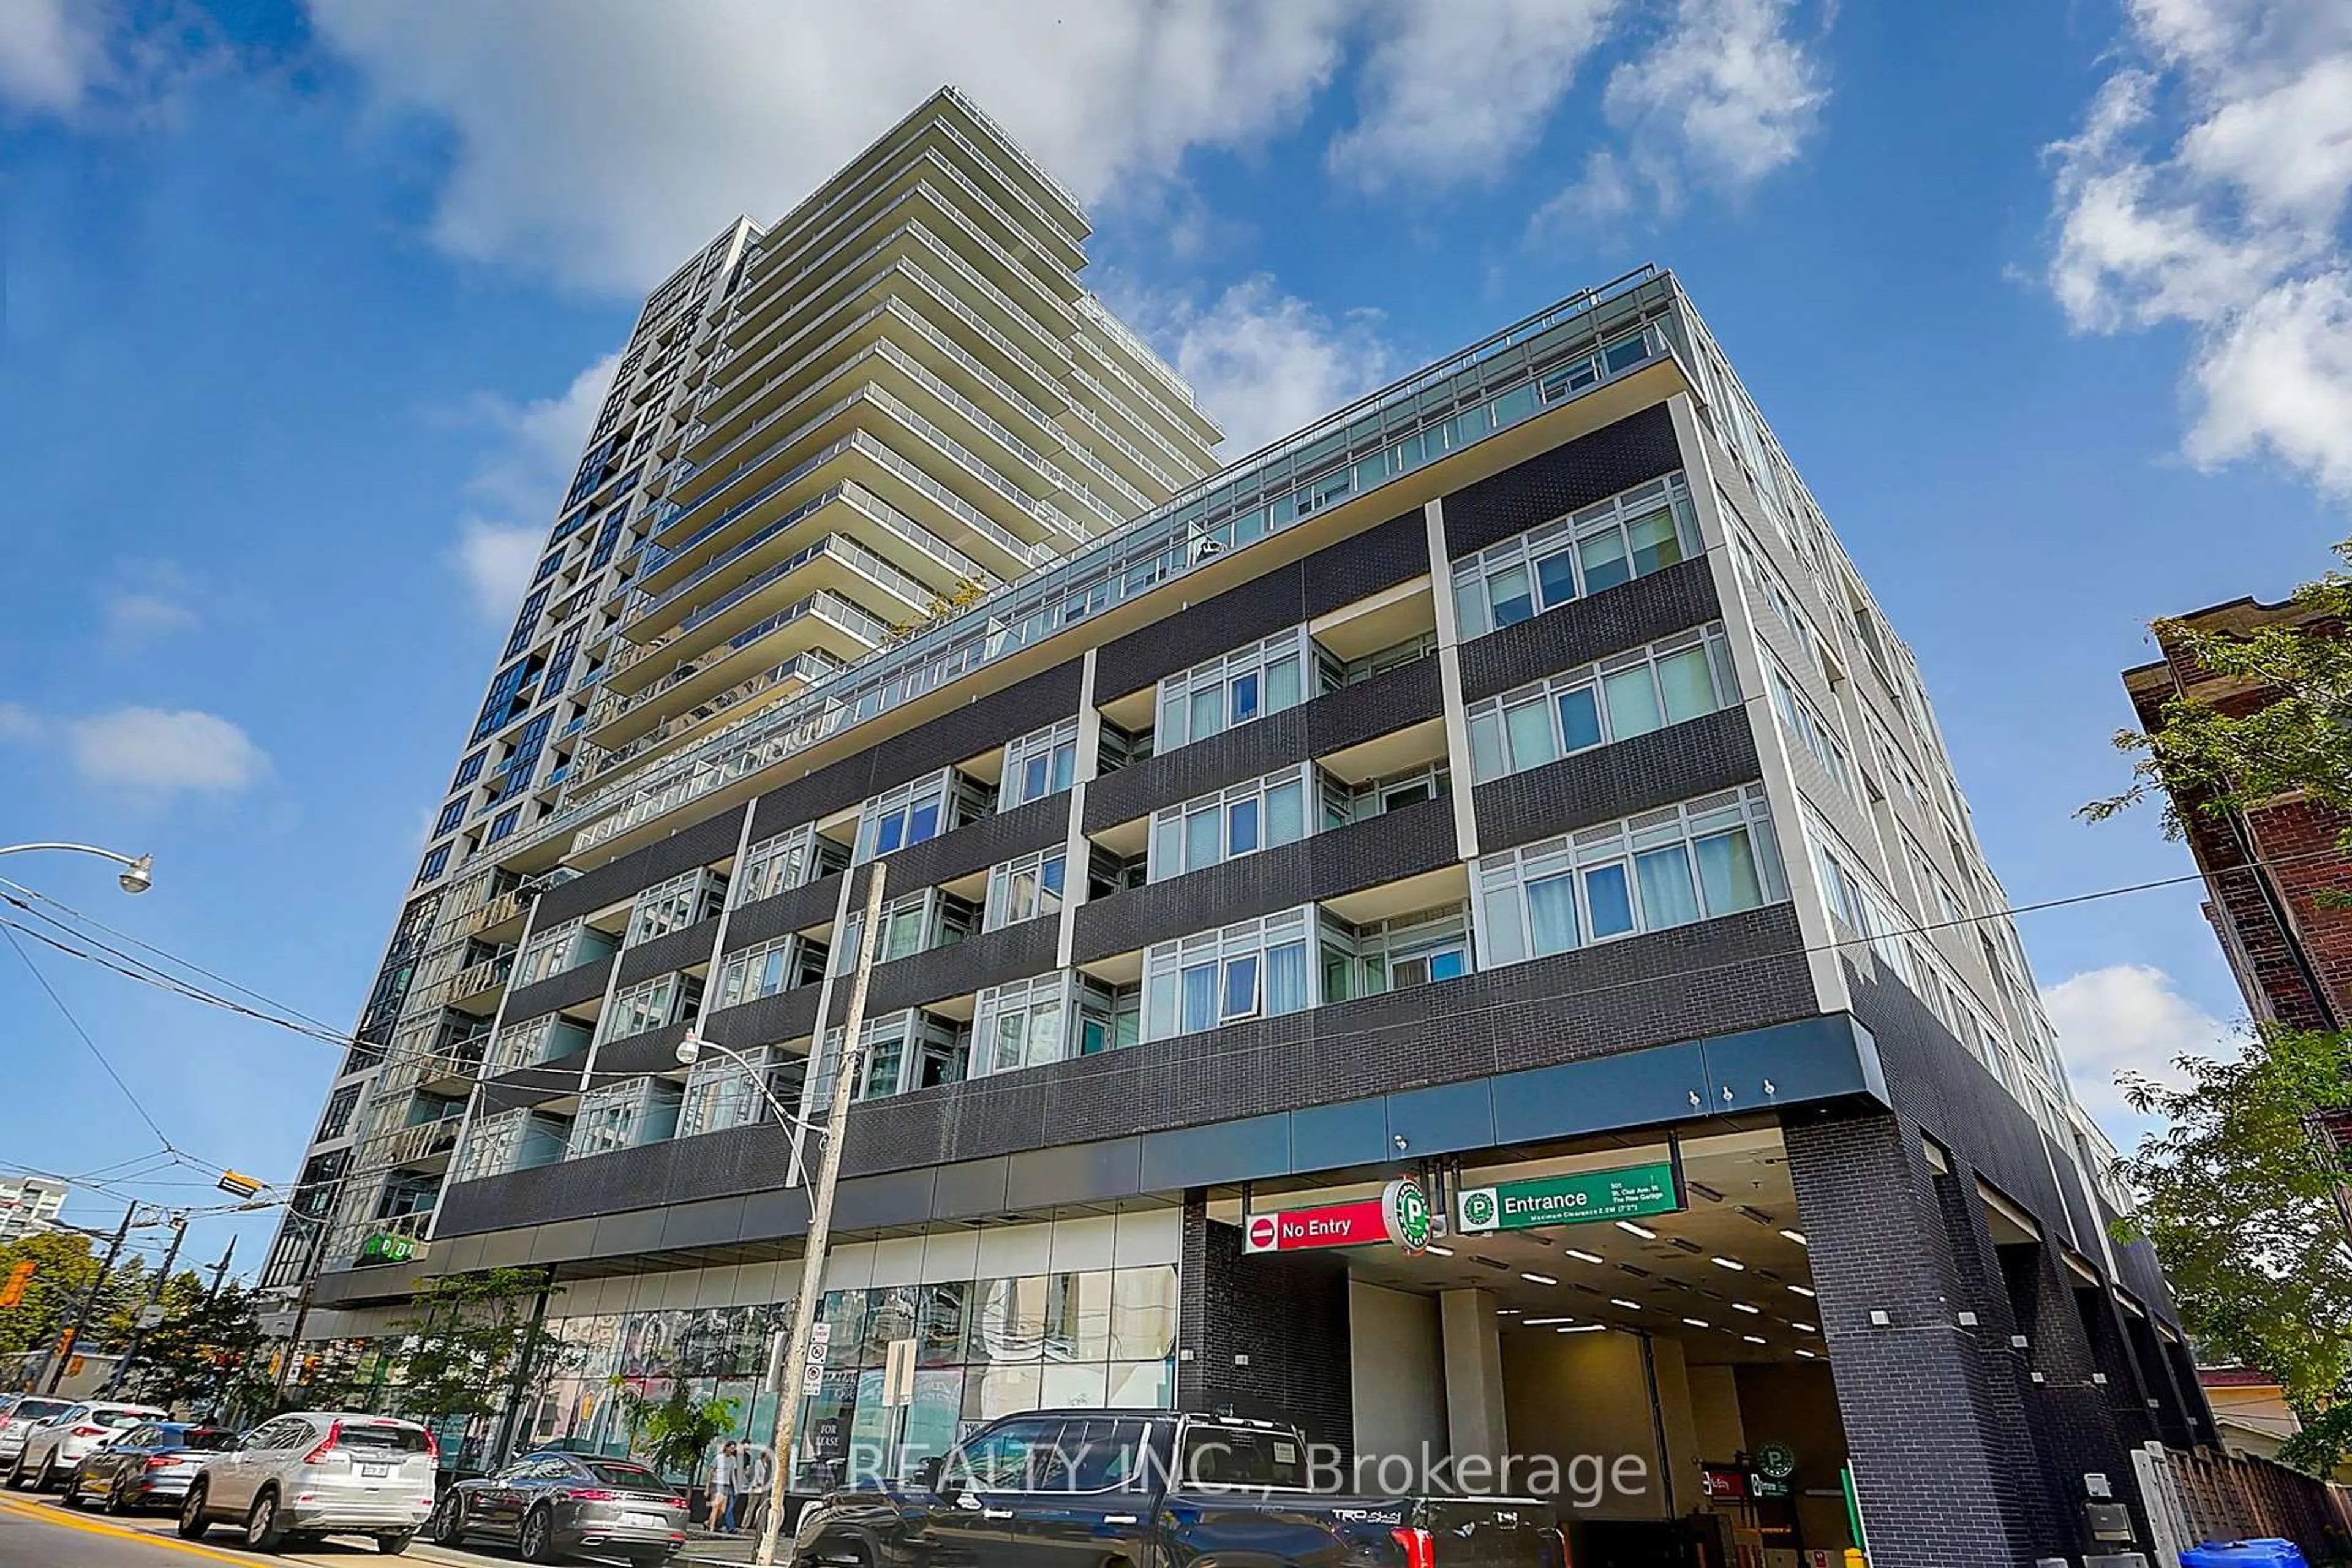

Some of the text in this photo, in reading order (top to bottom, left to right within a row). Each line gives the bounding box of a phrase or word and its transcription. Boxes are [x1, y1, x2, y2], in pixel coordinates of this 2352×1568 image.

[1408, 1198, 1422, 1223] P
[1474, 1201, 1485, 1213] P
[1505, 1193, 1588, 1214] Entrance
[1283, 1219, 1351, 1238] No Entry
[821, 1424, 837, 1434] FOR
